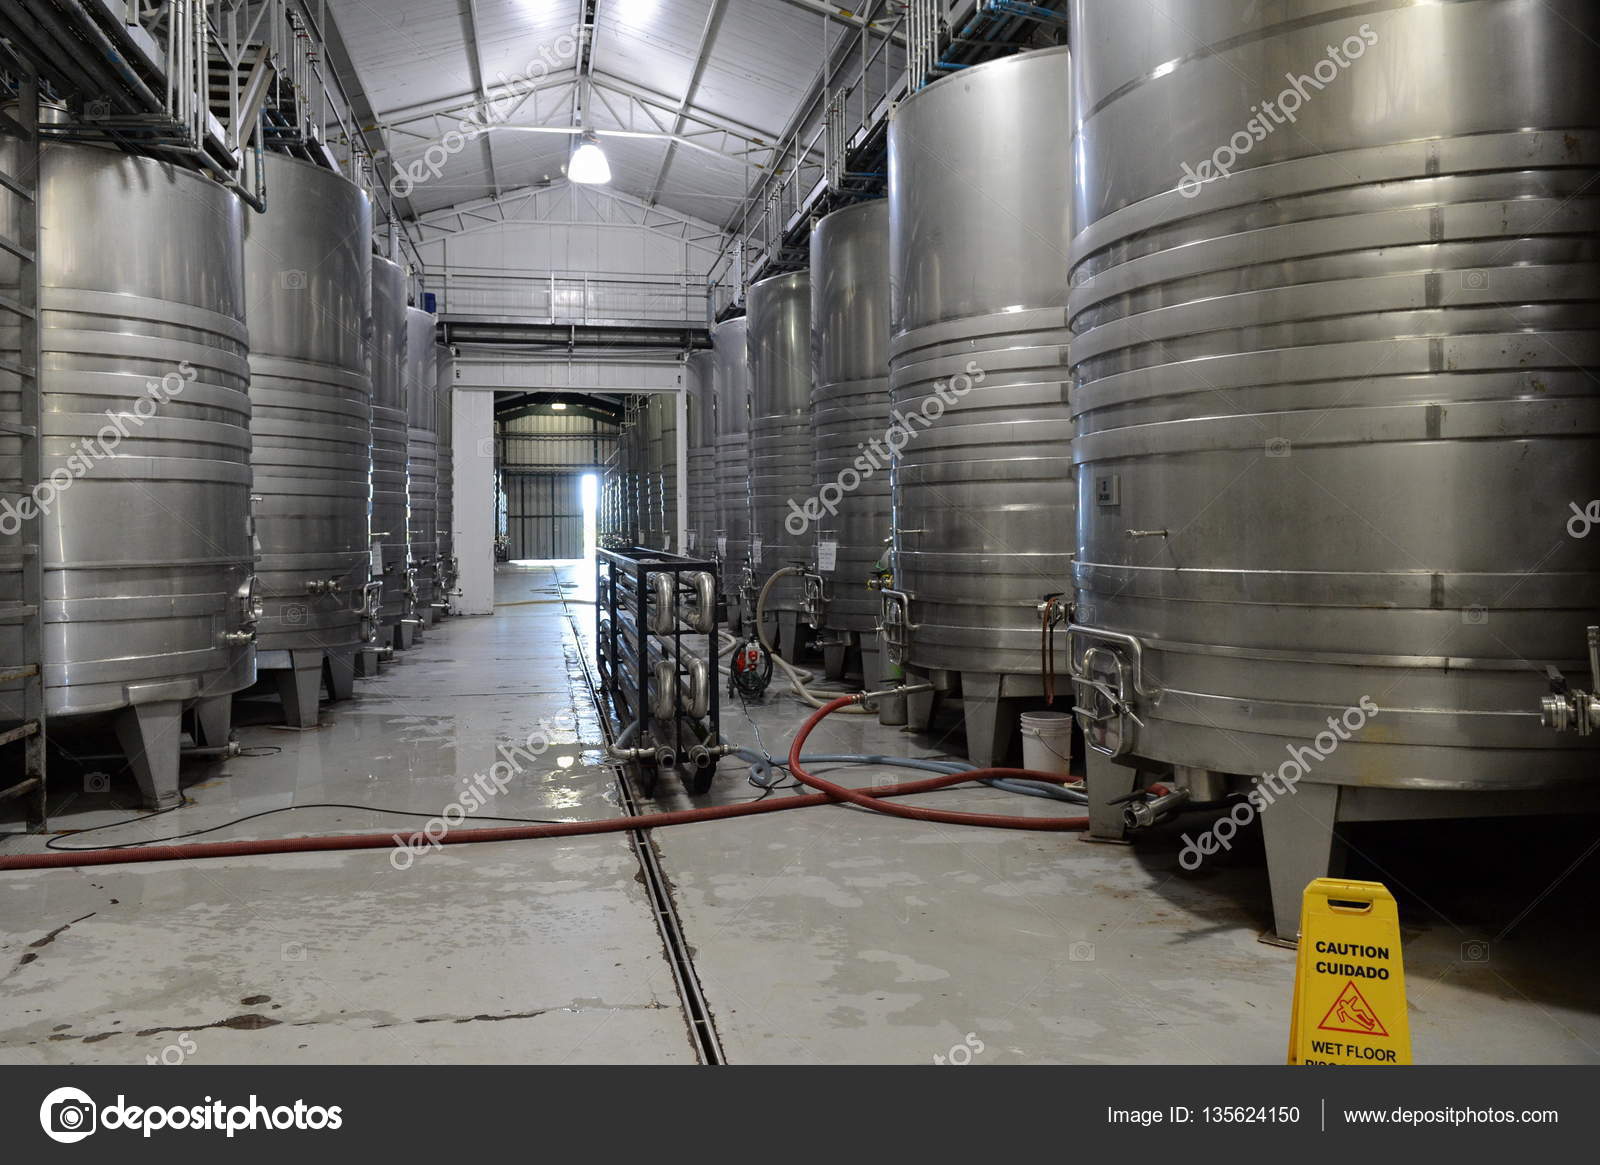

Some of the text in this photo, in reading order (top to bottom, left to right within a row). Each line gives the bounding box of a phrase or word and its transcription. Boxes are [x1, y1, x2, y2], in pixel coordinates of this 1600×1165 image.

[1315, 941, 1390, 960] CAUTION
[1315, 961, 1390, 981] CUIDADO
[1311, 1040, 1398, 1064] WET FLOOR
